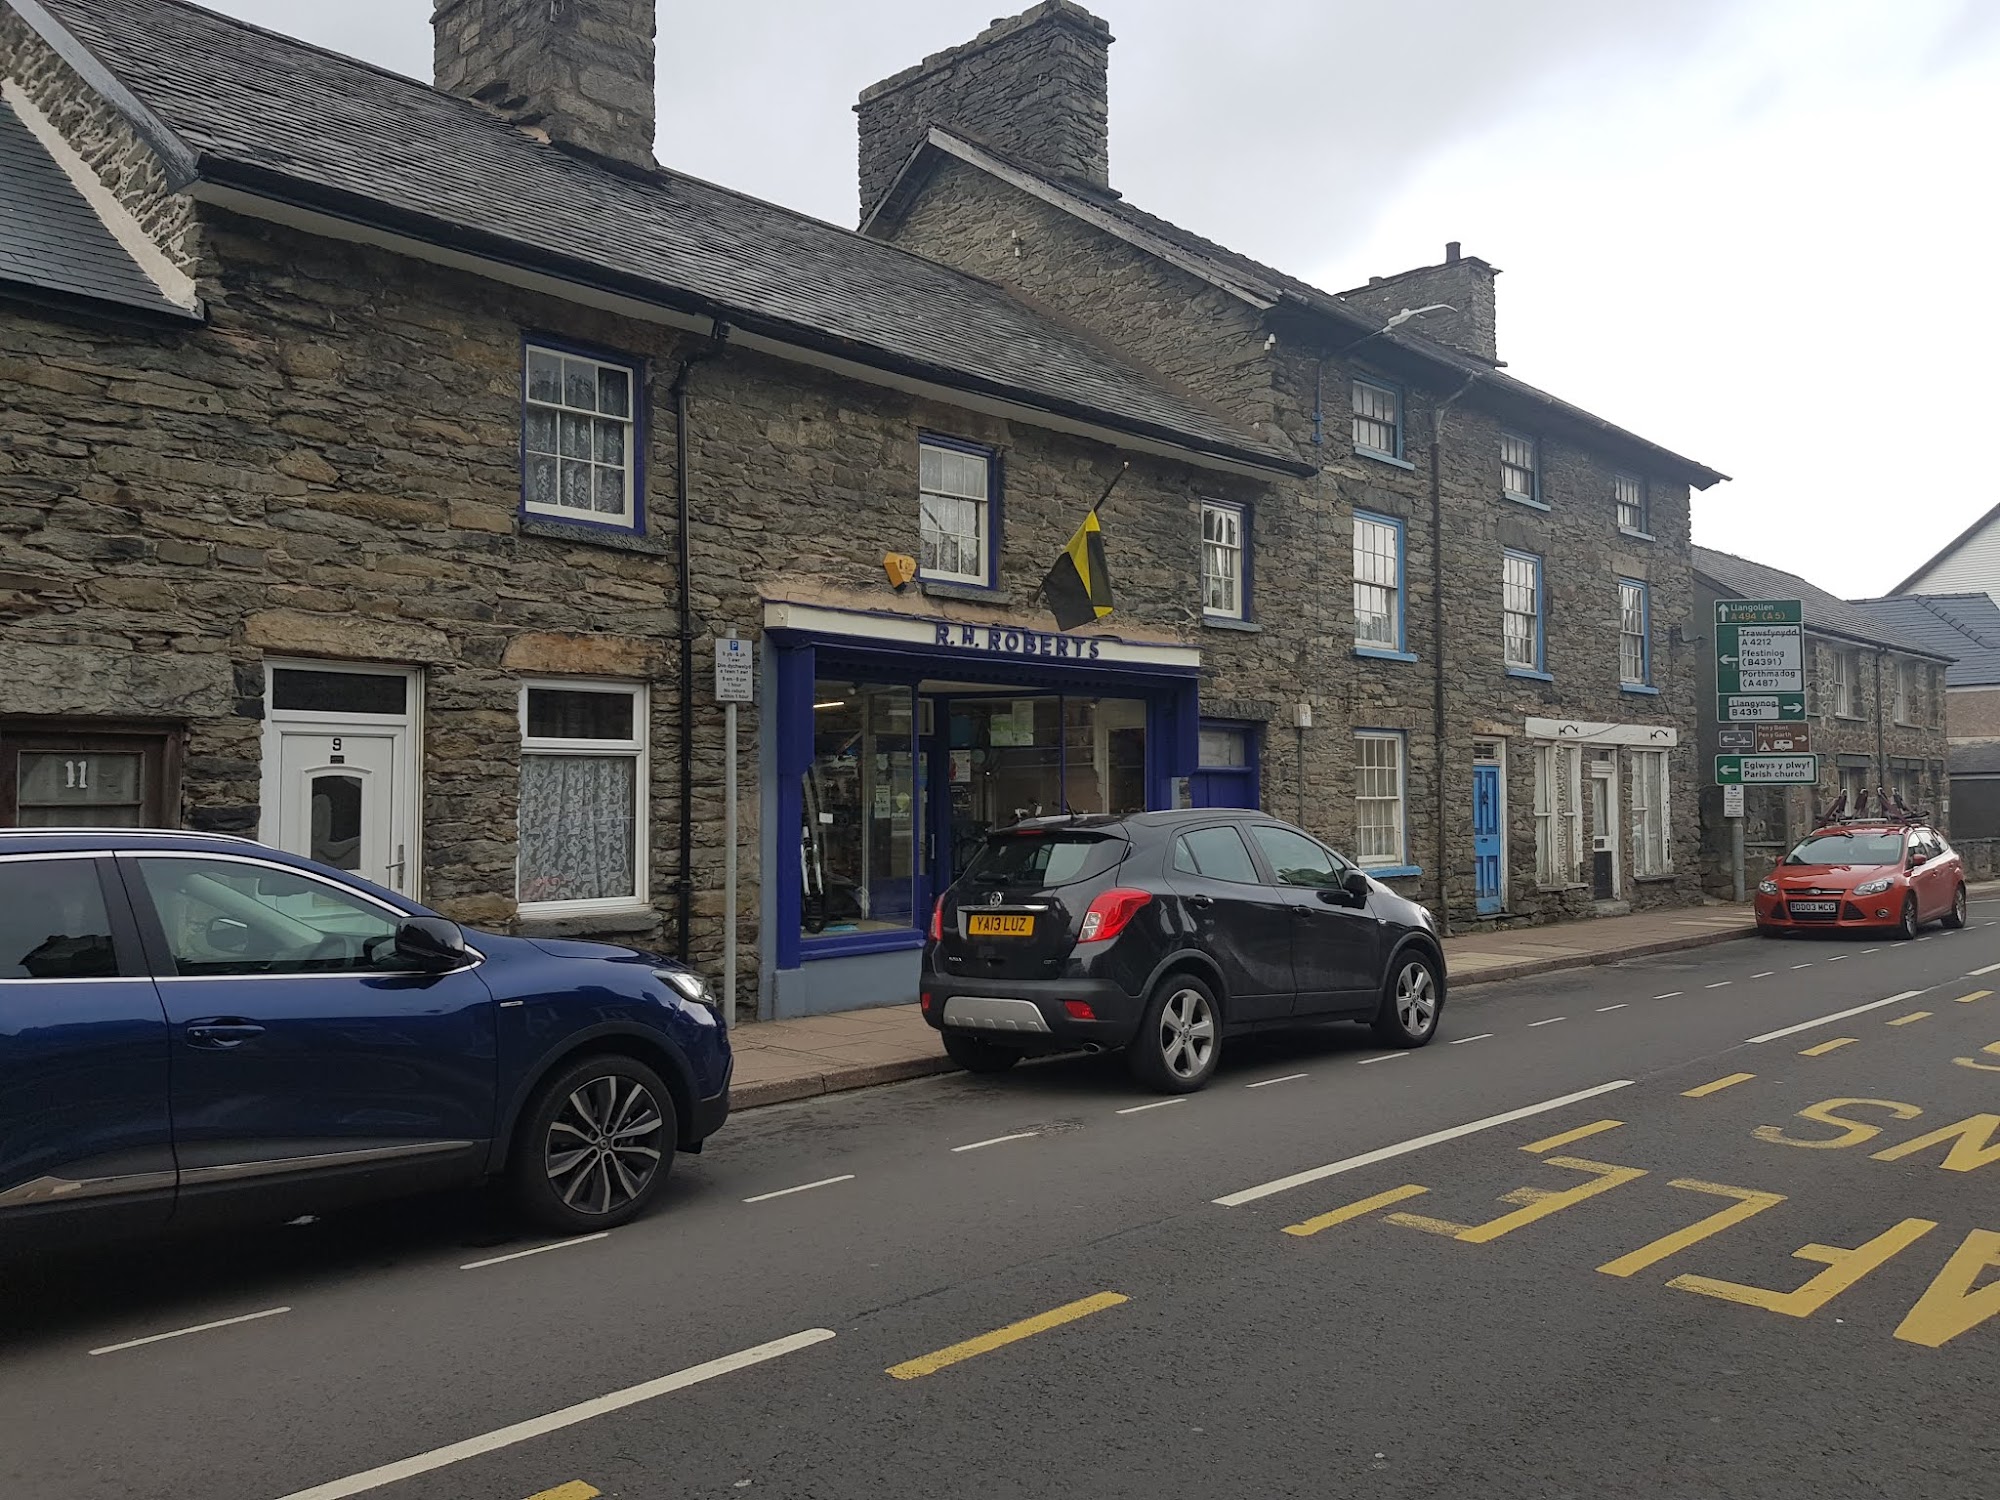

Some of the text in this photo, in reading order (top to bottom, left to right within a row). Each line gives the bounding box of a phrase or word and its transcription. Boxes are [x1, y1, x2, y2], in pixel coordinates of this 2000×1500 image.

[1730, 604, 1774, 612] Llangollen
[1741, 629, 1797, 637] Trawsfynydd
[988, 629, 1100, 658] ROBERTS
[1742, 658, 1782, 666] (B4391)
[1742, 670, 1795, 678] Porthmadog
[1732, 700, 1776, 708] Llangynog
[332, 738, 342, 751] 9
[1744, 762, 1775, 770] Eglwys
[1786, 762, 1810, 770] plwyf
[64, 760, 88, 788] 11
[978, 917, 1027, 931] YA13 LUZ
